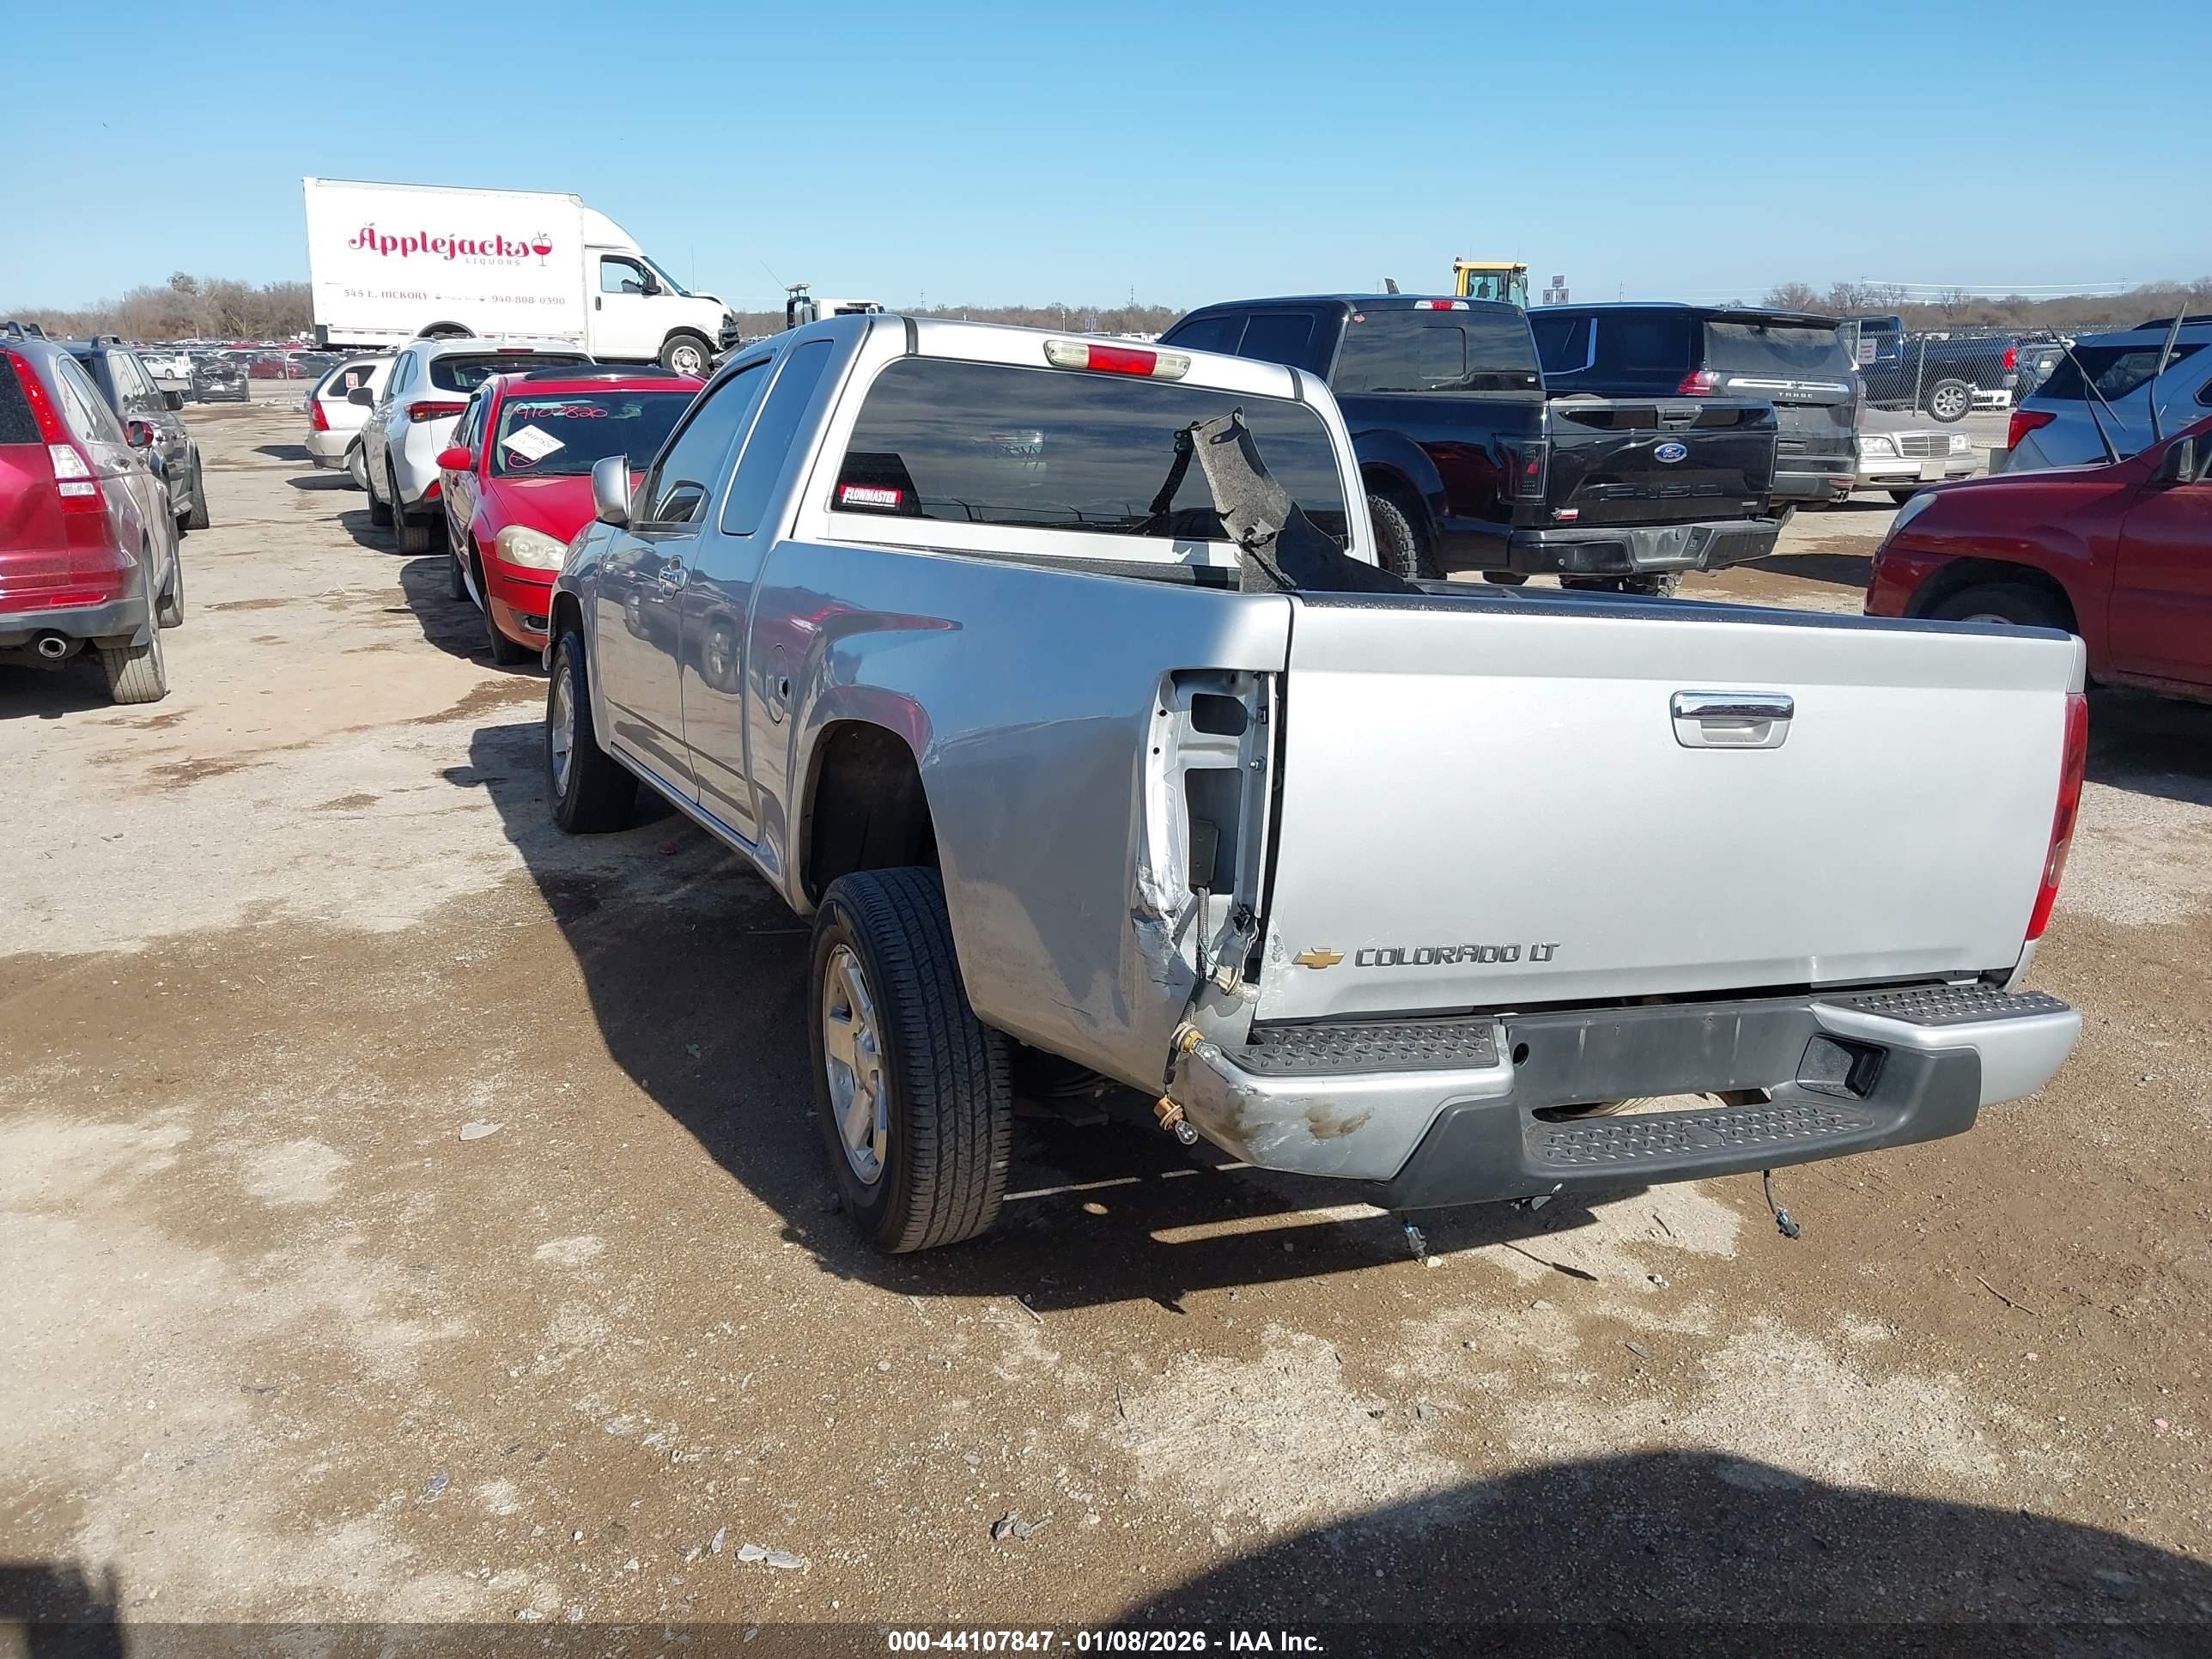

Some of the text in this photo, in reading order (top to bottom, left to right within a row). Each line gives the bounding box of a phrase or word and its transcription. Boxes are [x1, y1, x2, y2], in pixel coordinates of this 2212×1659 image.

[348, 223, 530, 261] Applejacks
[465, 258, 521, 266] LIQUORS
[381, 290, 428, 301] HICKORY
[1662, 447, 1682, 459] Ford
[842, 486, 896, 505] FLOWMASTER
[1354, 941, 1561, 968] COLORADO LT
